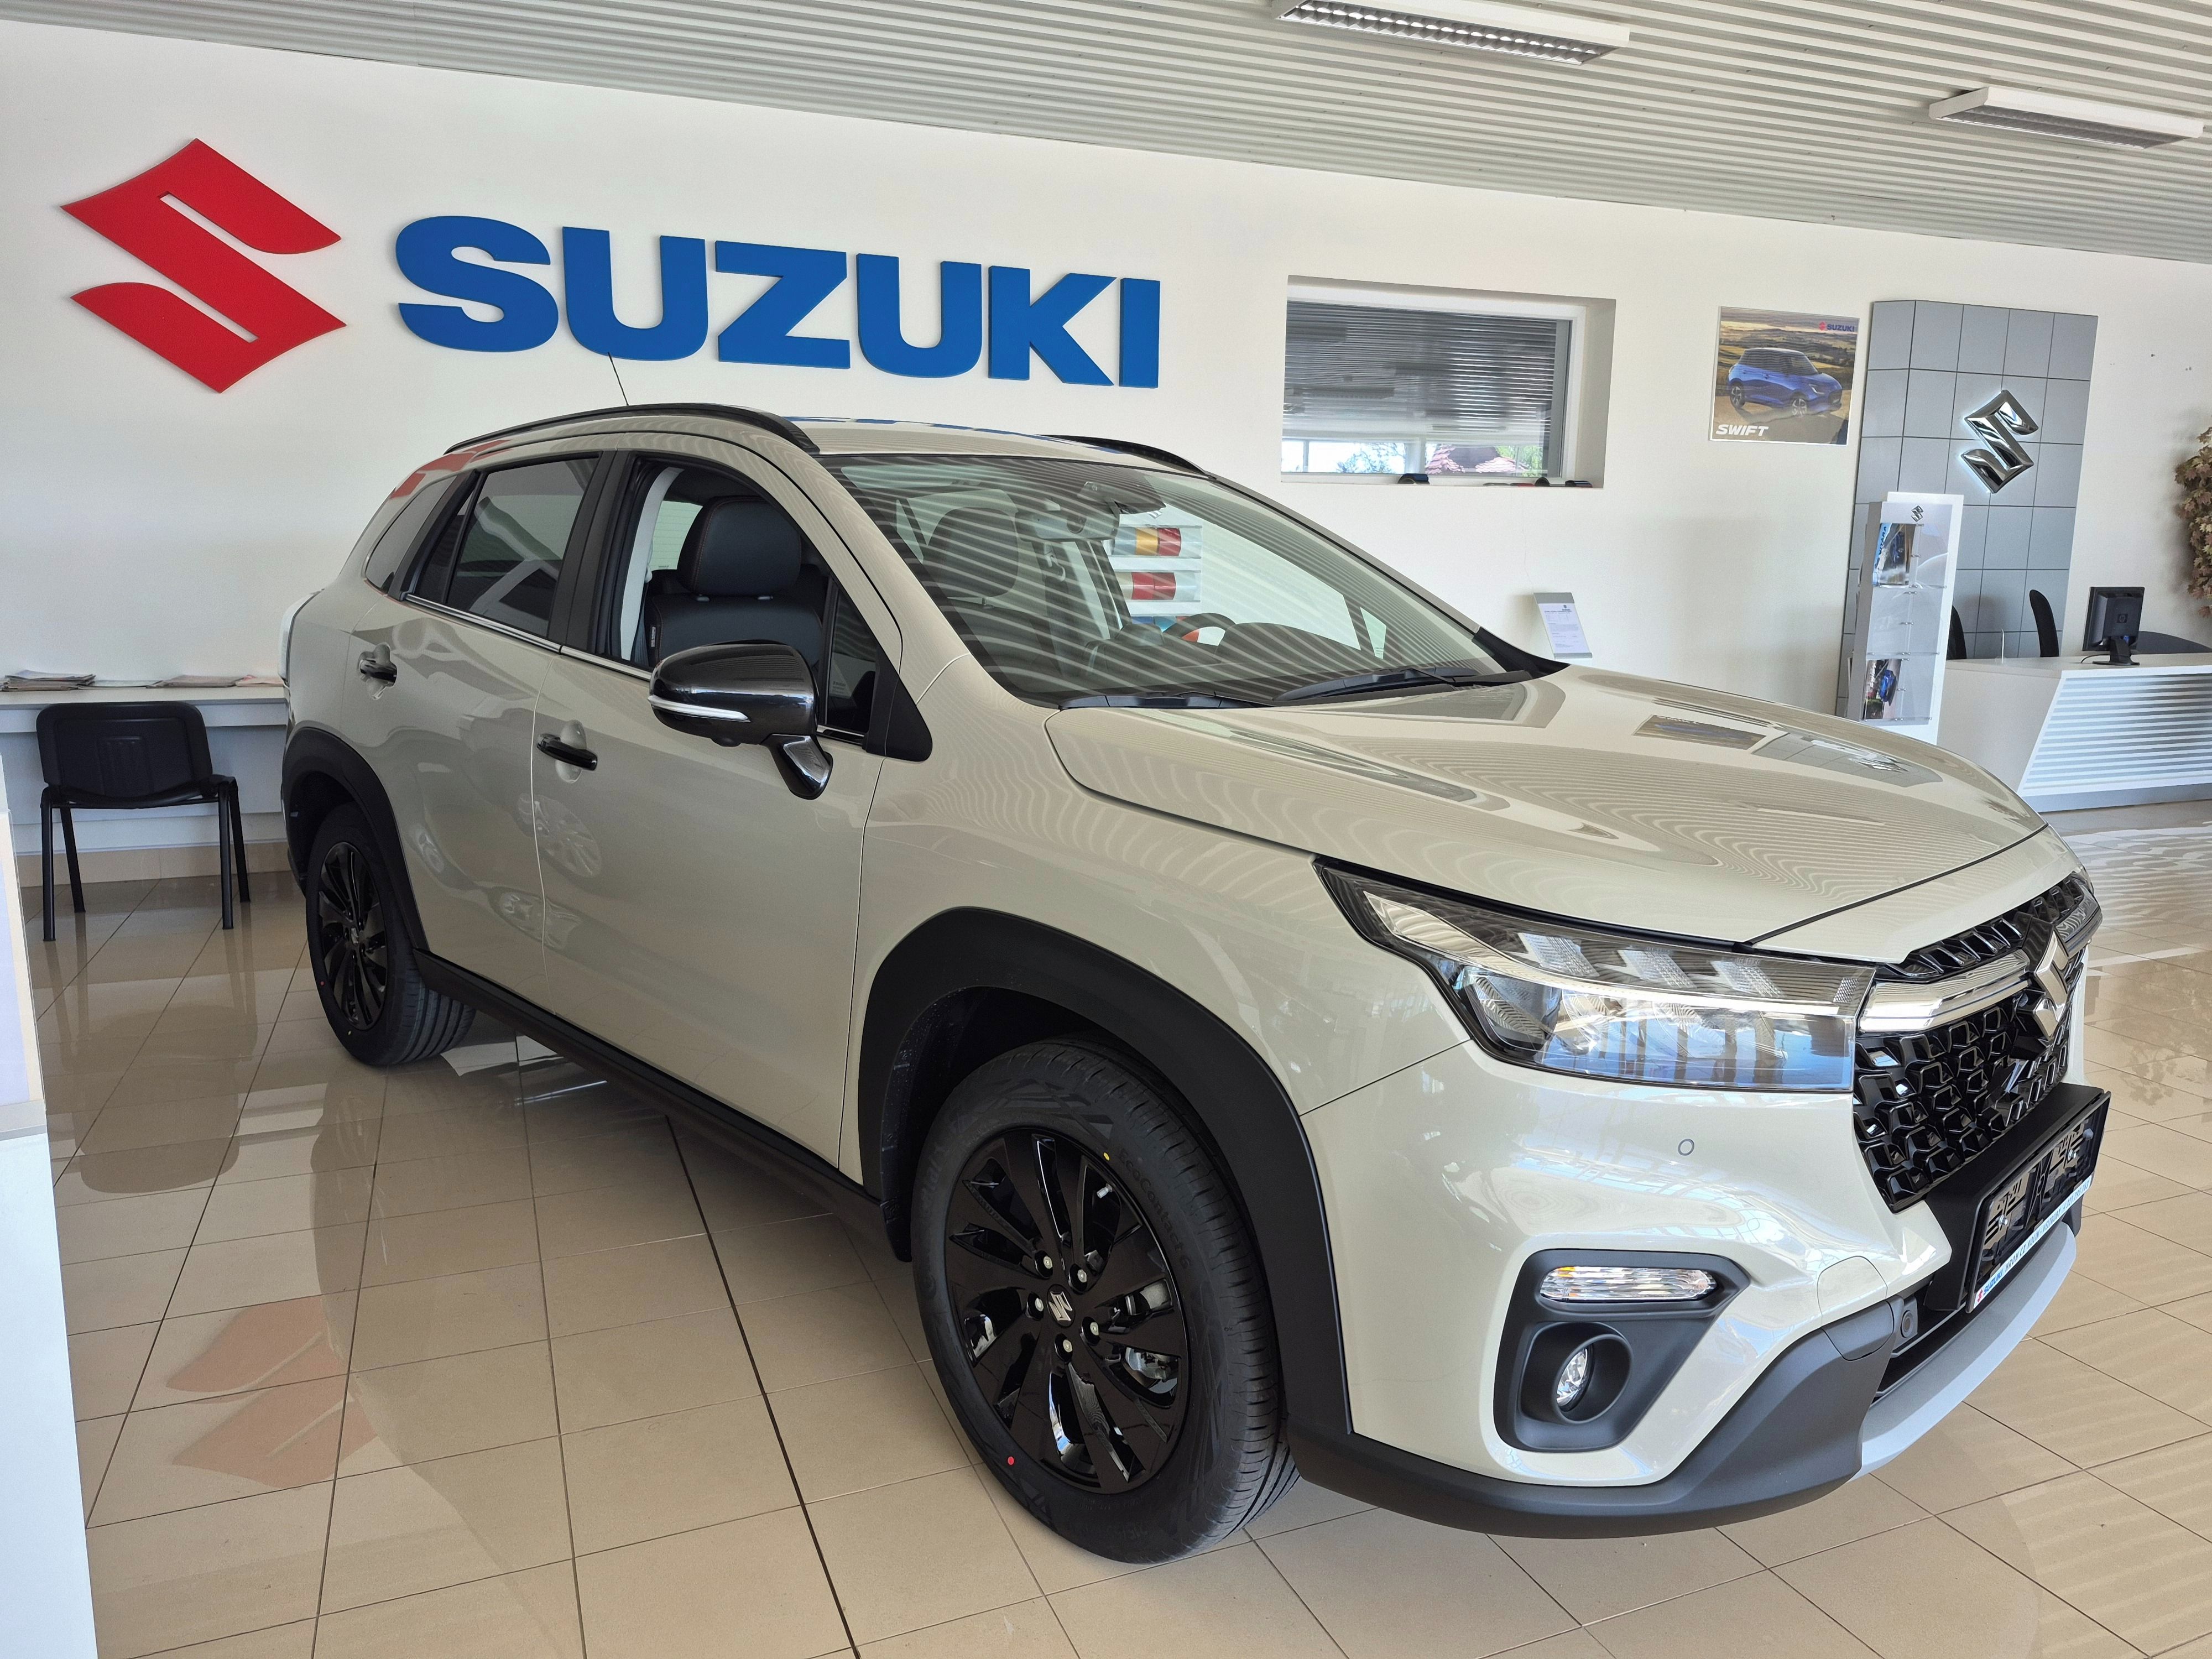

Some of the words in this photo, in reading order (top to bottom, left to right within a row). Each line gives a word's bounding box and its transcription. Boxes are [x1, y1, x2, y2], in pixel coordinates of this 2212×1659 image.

[395, 215, 1160, 389] SUZUKI
[1827, 324, 1855, 332] SUZUKI
[1716, 424, 1769, 436] SWIFT
[1119, 1148, 1182, 1251] EcoContact
[1178, 1254, 1191, 1270] 6
